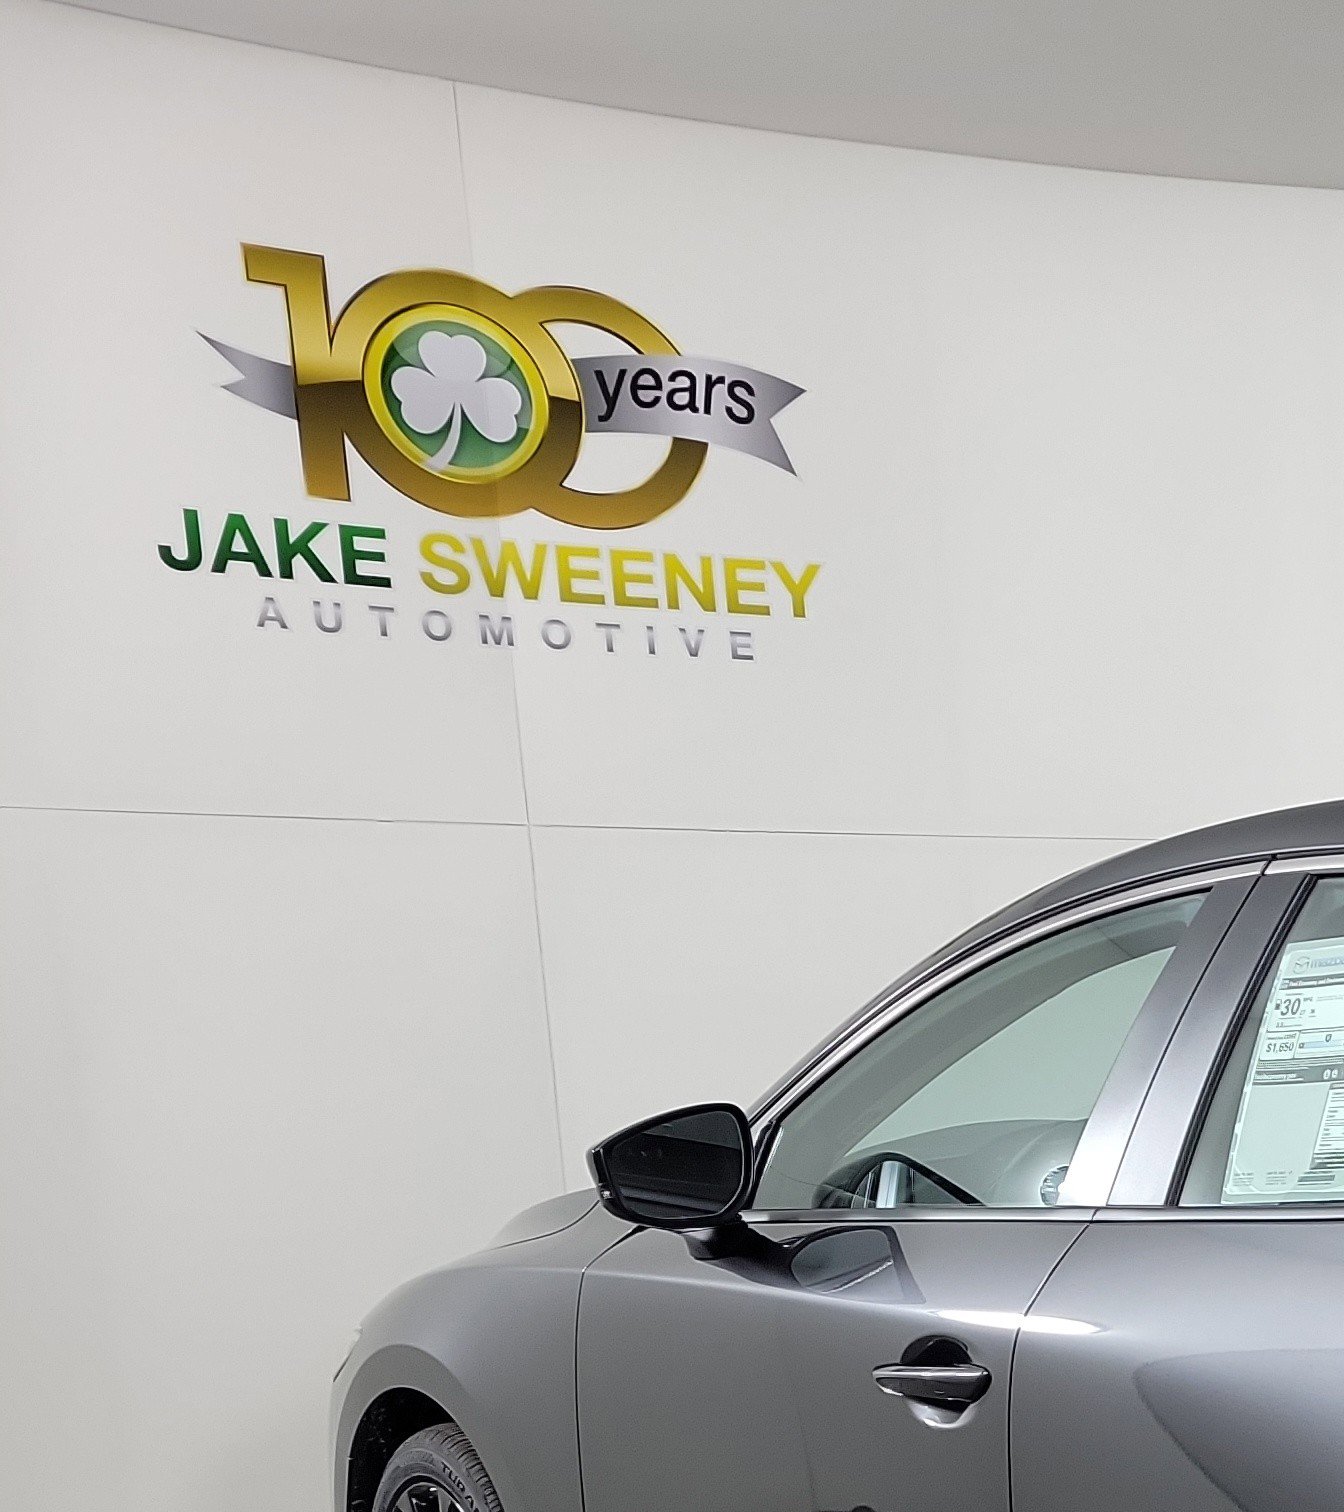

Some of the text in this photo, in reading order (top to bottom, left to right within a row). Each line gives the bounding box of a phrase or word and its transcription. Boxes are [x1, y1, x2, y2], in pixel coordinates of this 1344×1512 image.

[240, 241, 709, 530] 100
[593, 364, 757, 426] years
[157, 507, 822, 620] JAKE SWEENEY
[256, 595, 757, 662] AUTOMOTIVE
[1280, 998, 1301, 1016] 30
